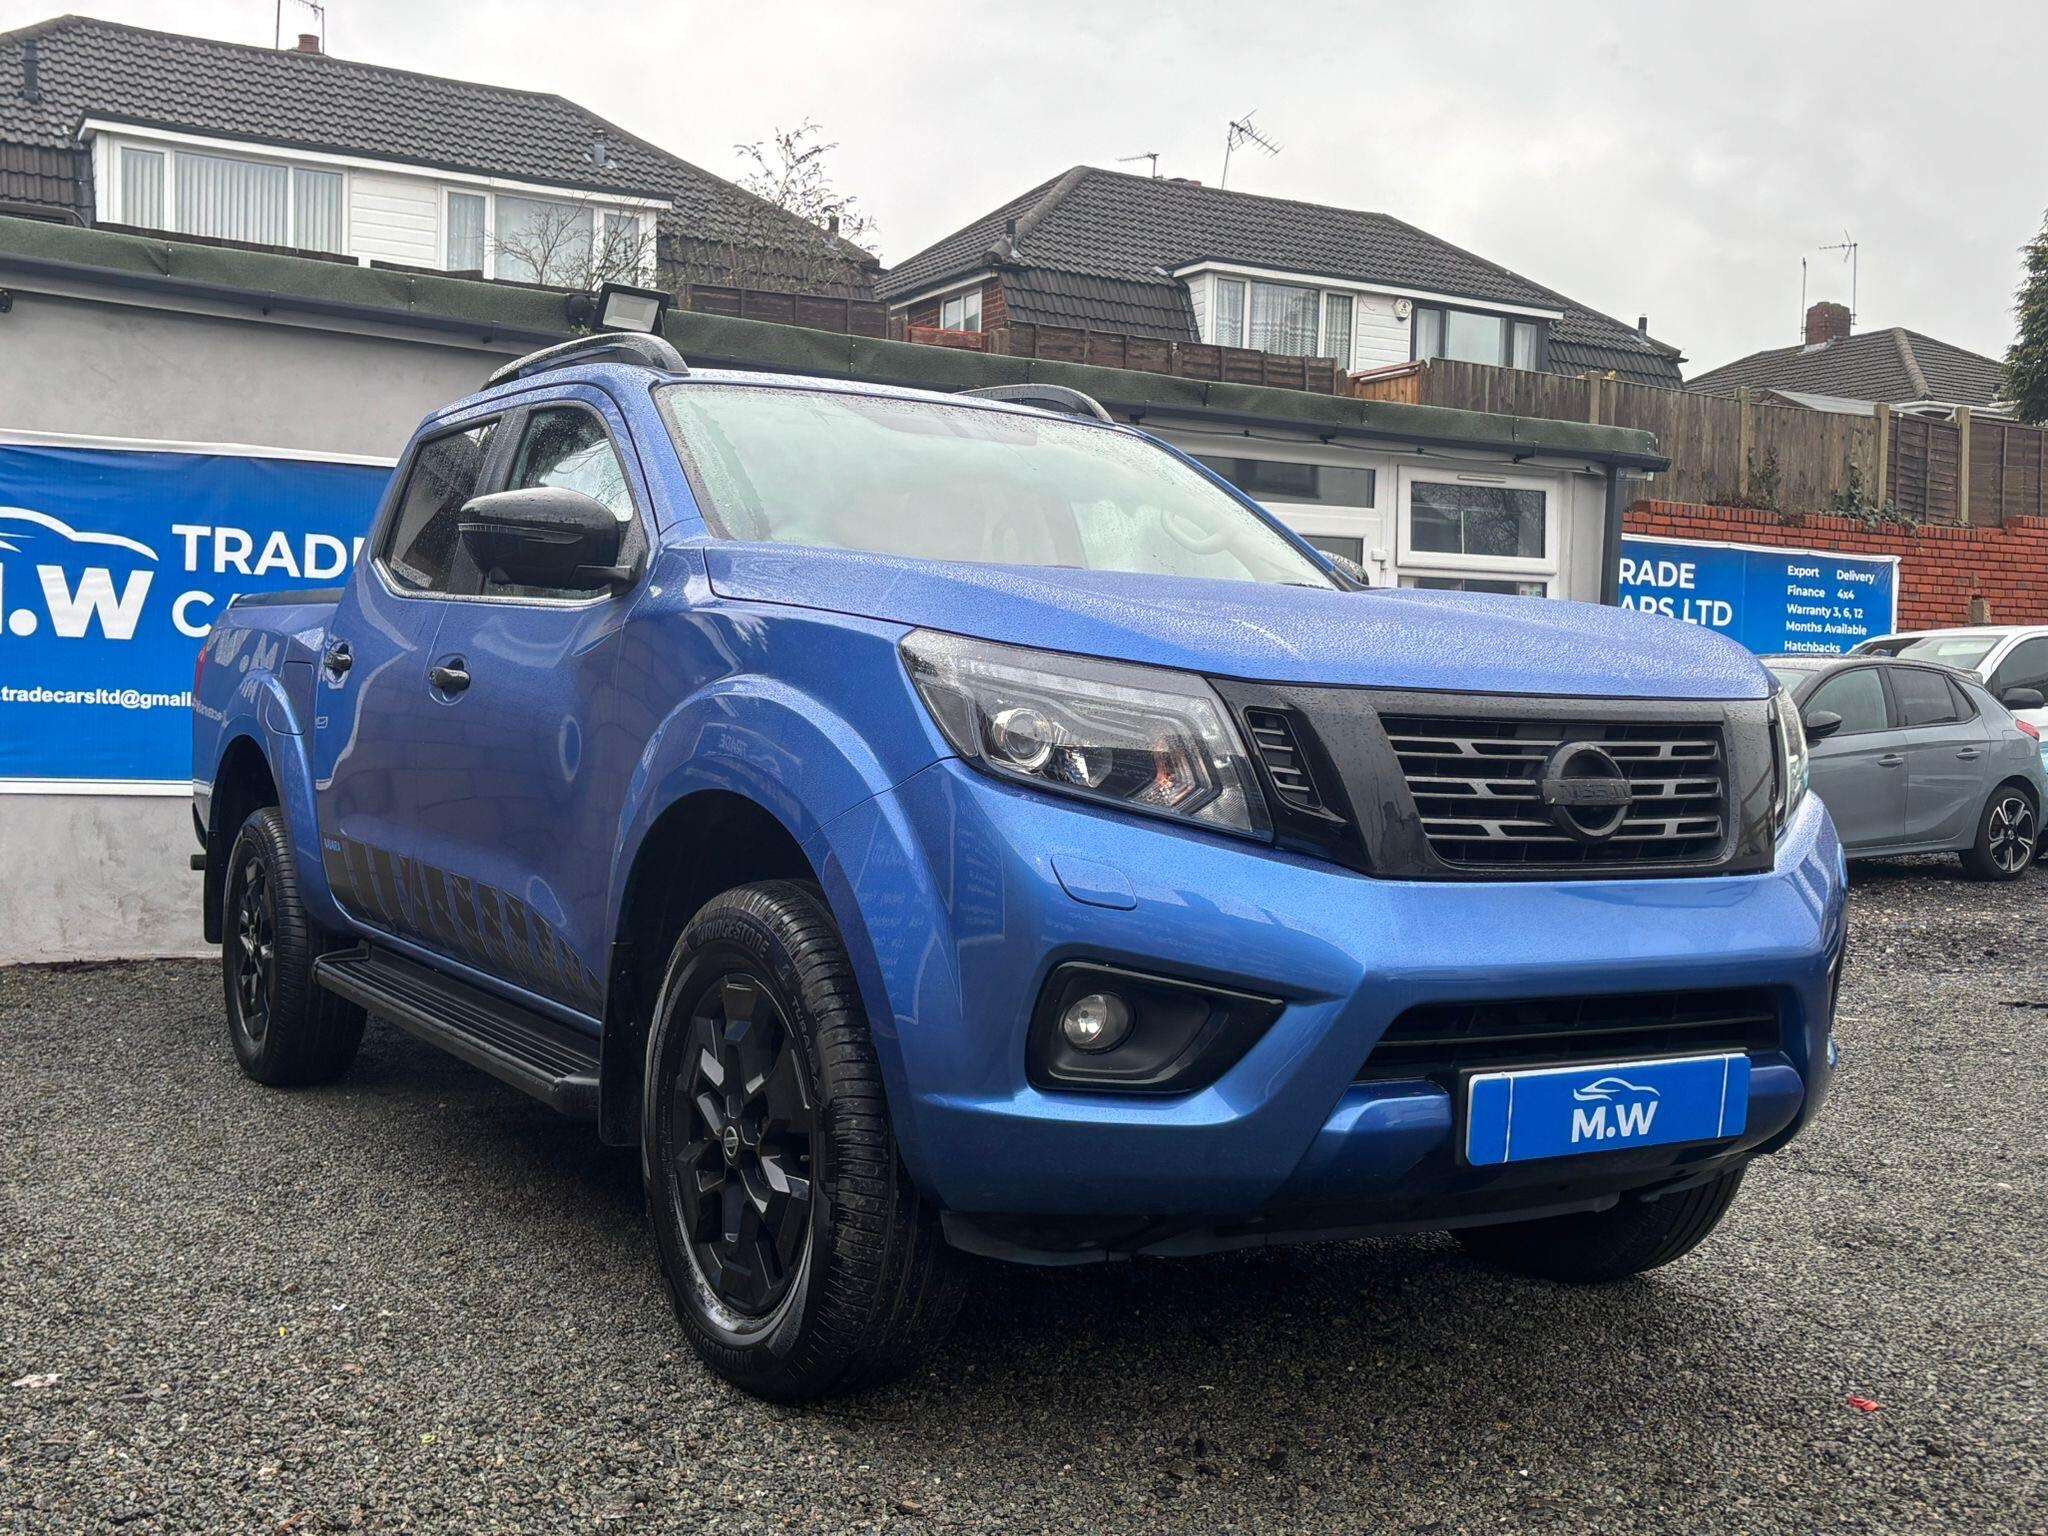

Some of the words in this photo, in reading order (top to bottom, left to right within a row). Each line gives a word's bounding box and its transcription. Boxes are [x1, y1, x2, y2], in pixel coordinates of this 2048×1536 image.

[171, 523, 366, 579] TRAD
[1787, 565, 1820, 578] Export
[1836, 569, 1875, 585] Delivery
[0, 562, 154, 640] .W
[1787, 584, 1826, 598] Finance
[1837, 589, 1855, 599] 4x4
[171, 590, 240, 638] C
[1682, 598, 1733, 627] LTD
[1786, 603, 1831, 619] Warranty
[1832, 607, 1841, 618] 3,
[1843, 608, 1852, 619] 6,
[1853, 608, 1864, 618] 12
[1785, 620, 1822, 633] Months
[1824, 623, 1867, 635] Available
[1784, 640, 1841, 653] Hatchbacks
[1571, 1101, 1658, 1143] M.W
